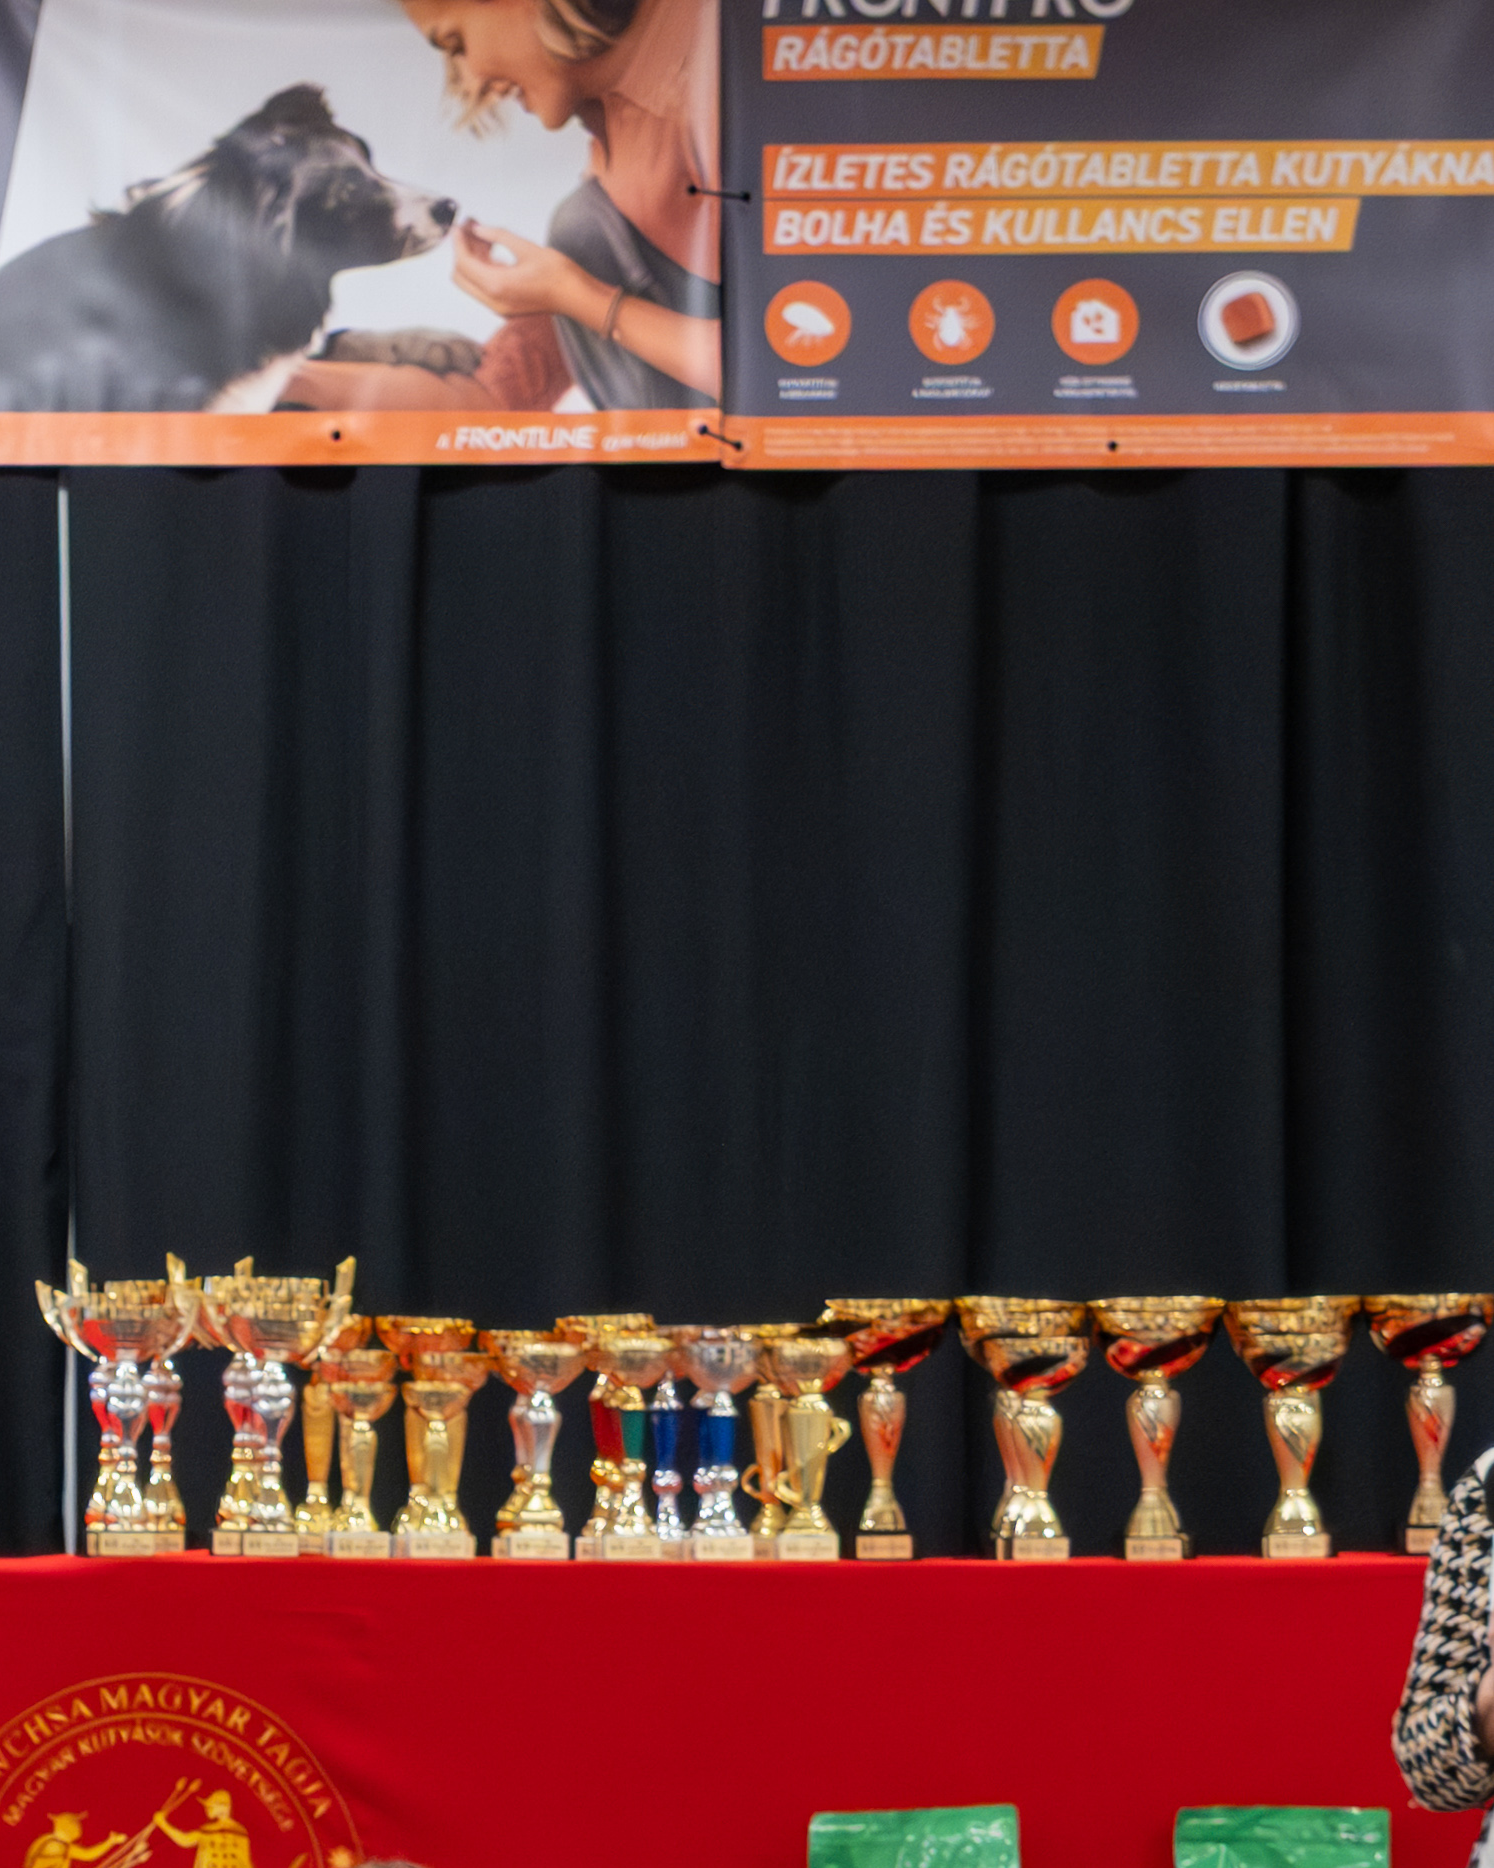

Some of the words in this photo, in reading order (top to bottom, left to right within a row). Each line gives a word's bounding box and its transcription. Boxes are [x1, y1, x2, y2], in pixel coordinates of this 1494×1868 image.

[772, 27, 1091, 71] RÁGÓTABLETTA
[772, 148, 934, 191] ÍZLETES
[943, 145, 1260, 189] RÁGÓTABLETTA
[1271, 142, 1494, 187] KUTYÁKNA
[773, 209, 910, 246] BOLHA
[920, 202, 971, 245] ÉS
[982, 208, 1202, 244] KULLANCS
[1211, 206, 1339, 243] ELLEN
[455, 427, 597, 450] FRONTLINE
[99, 1683, 252, 1734] MAGYAR
